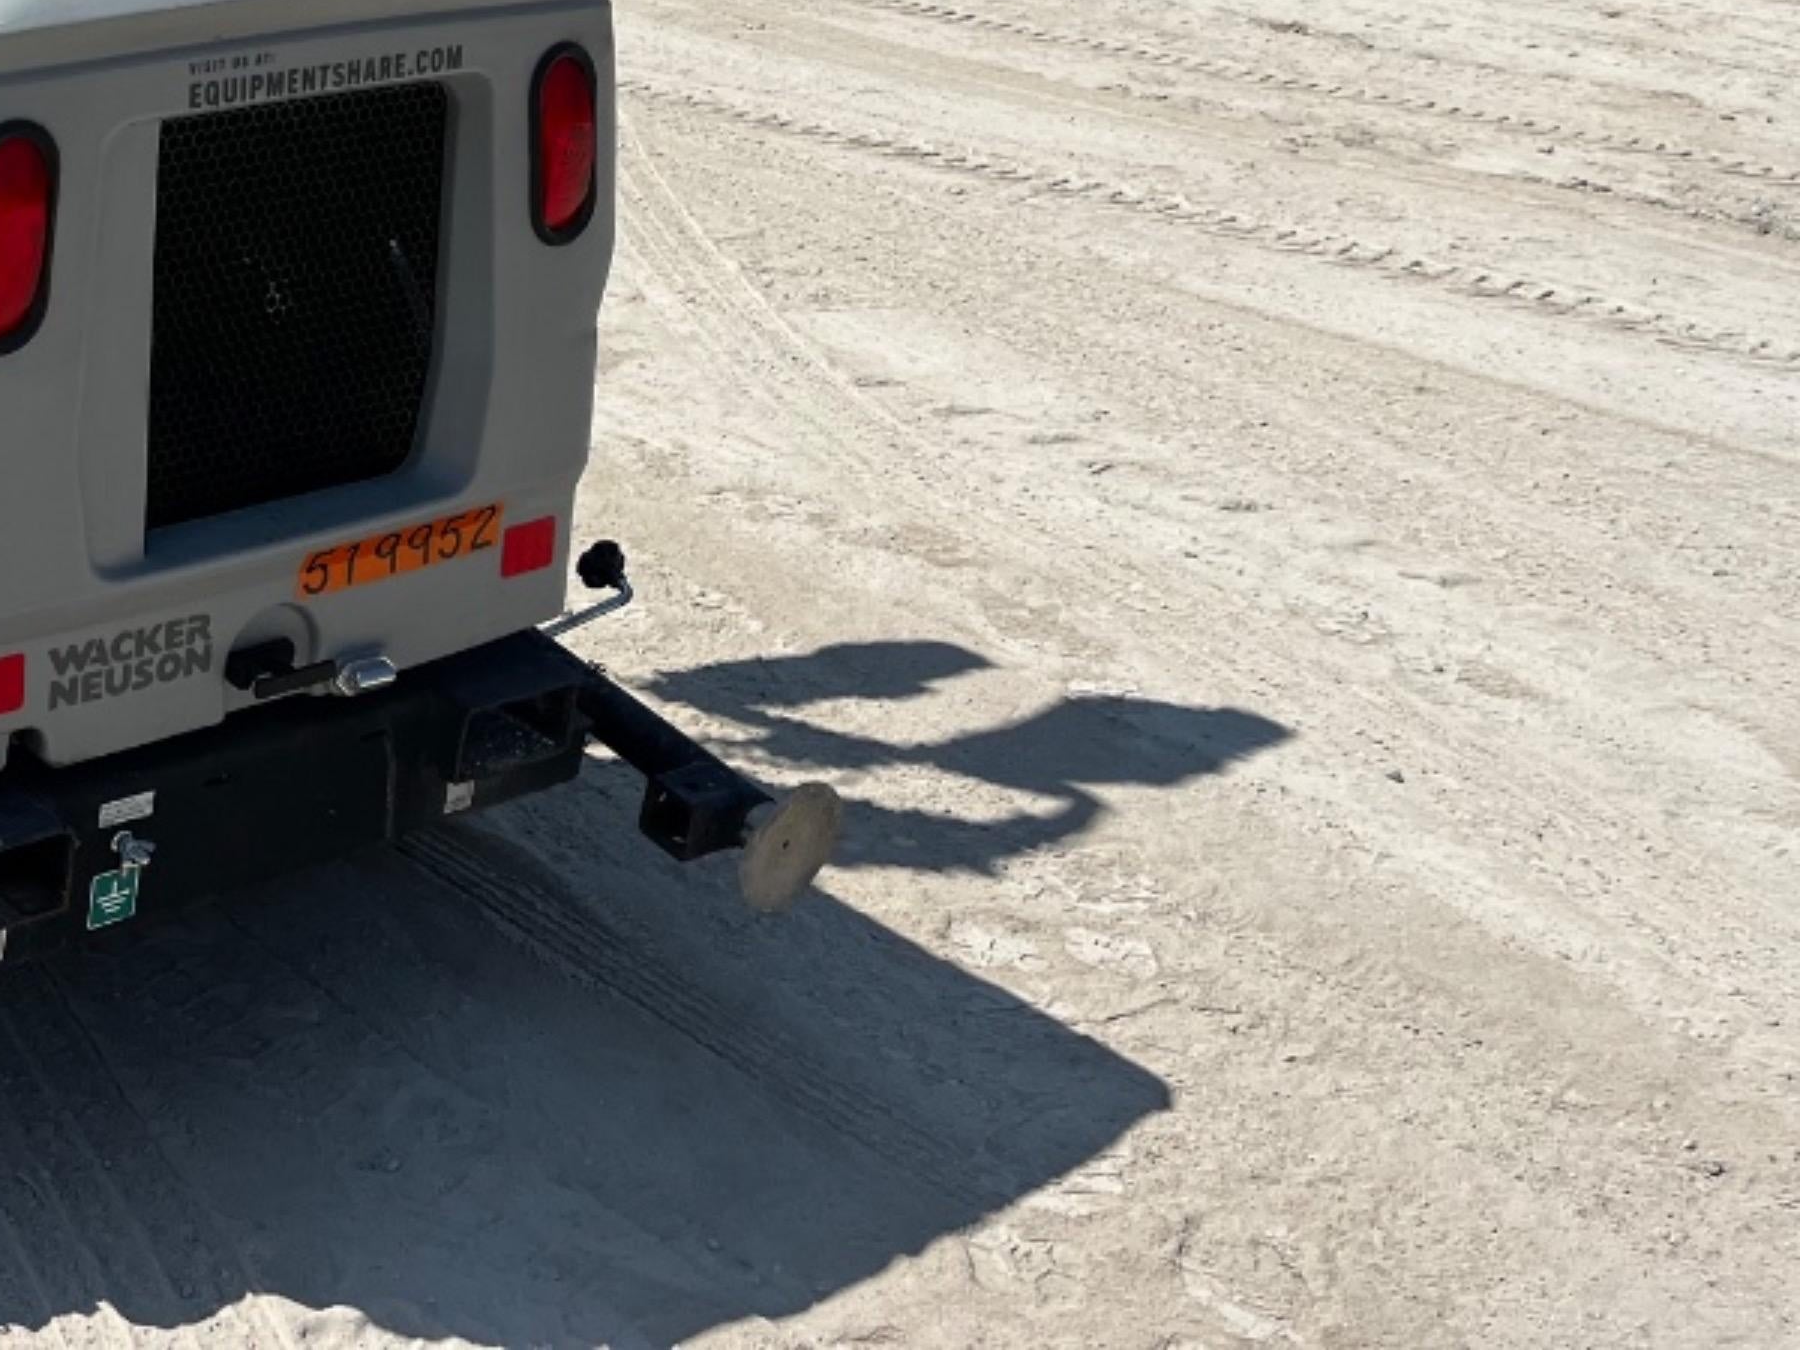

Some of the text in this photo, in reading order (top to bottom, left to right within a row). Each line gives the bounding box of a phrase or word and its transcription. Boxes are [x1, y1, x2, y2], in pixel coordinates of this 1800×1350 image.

[188, 44, 463, 110] EQUIPMENTSHARE.COM
[47, 613, 212, 674] WACKER
[47, 644, 212, 712] NEUSON
